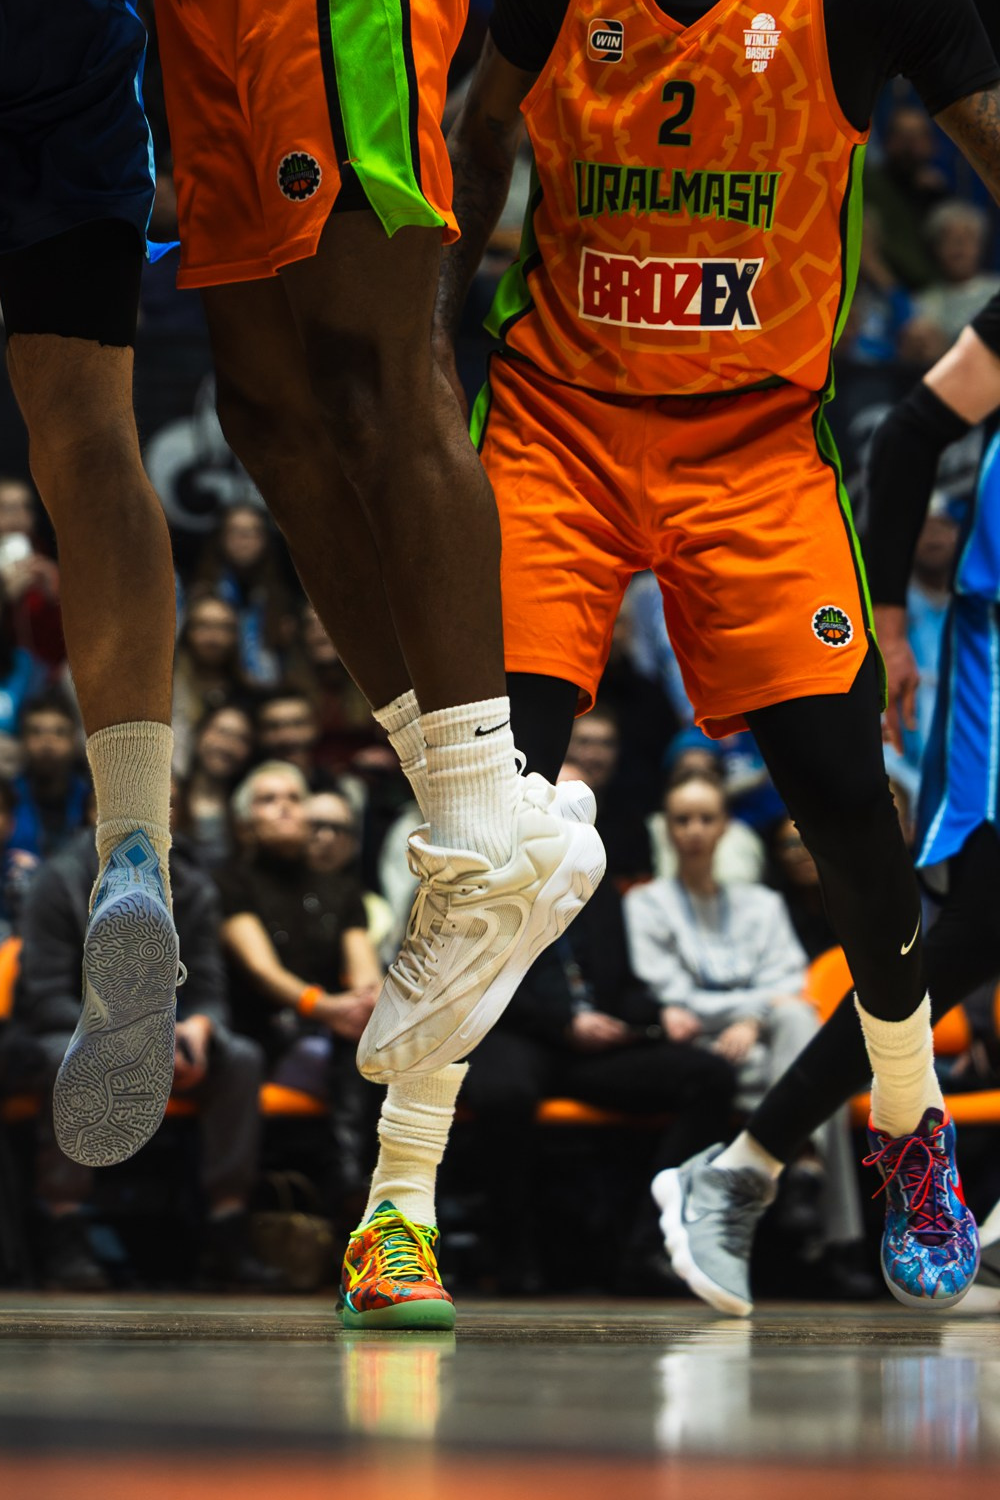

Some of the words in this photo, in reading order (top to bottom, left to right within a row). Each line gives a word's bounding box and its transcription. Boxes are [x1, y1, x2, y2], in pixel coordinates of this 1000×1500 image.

[595, 34, 621, 49] WIN
[744, 33, 779, 47] WINLINE
[745, 46, 776, 60] BASKET
[751, 60, 768, 74] CUP
[657, 79, 696, 147] 2
[574, 160, 783, 232] URALMASH
[581, 250, 762, 327] BROZEX
